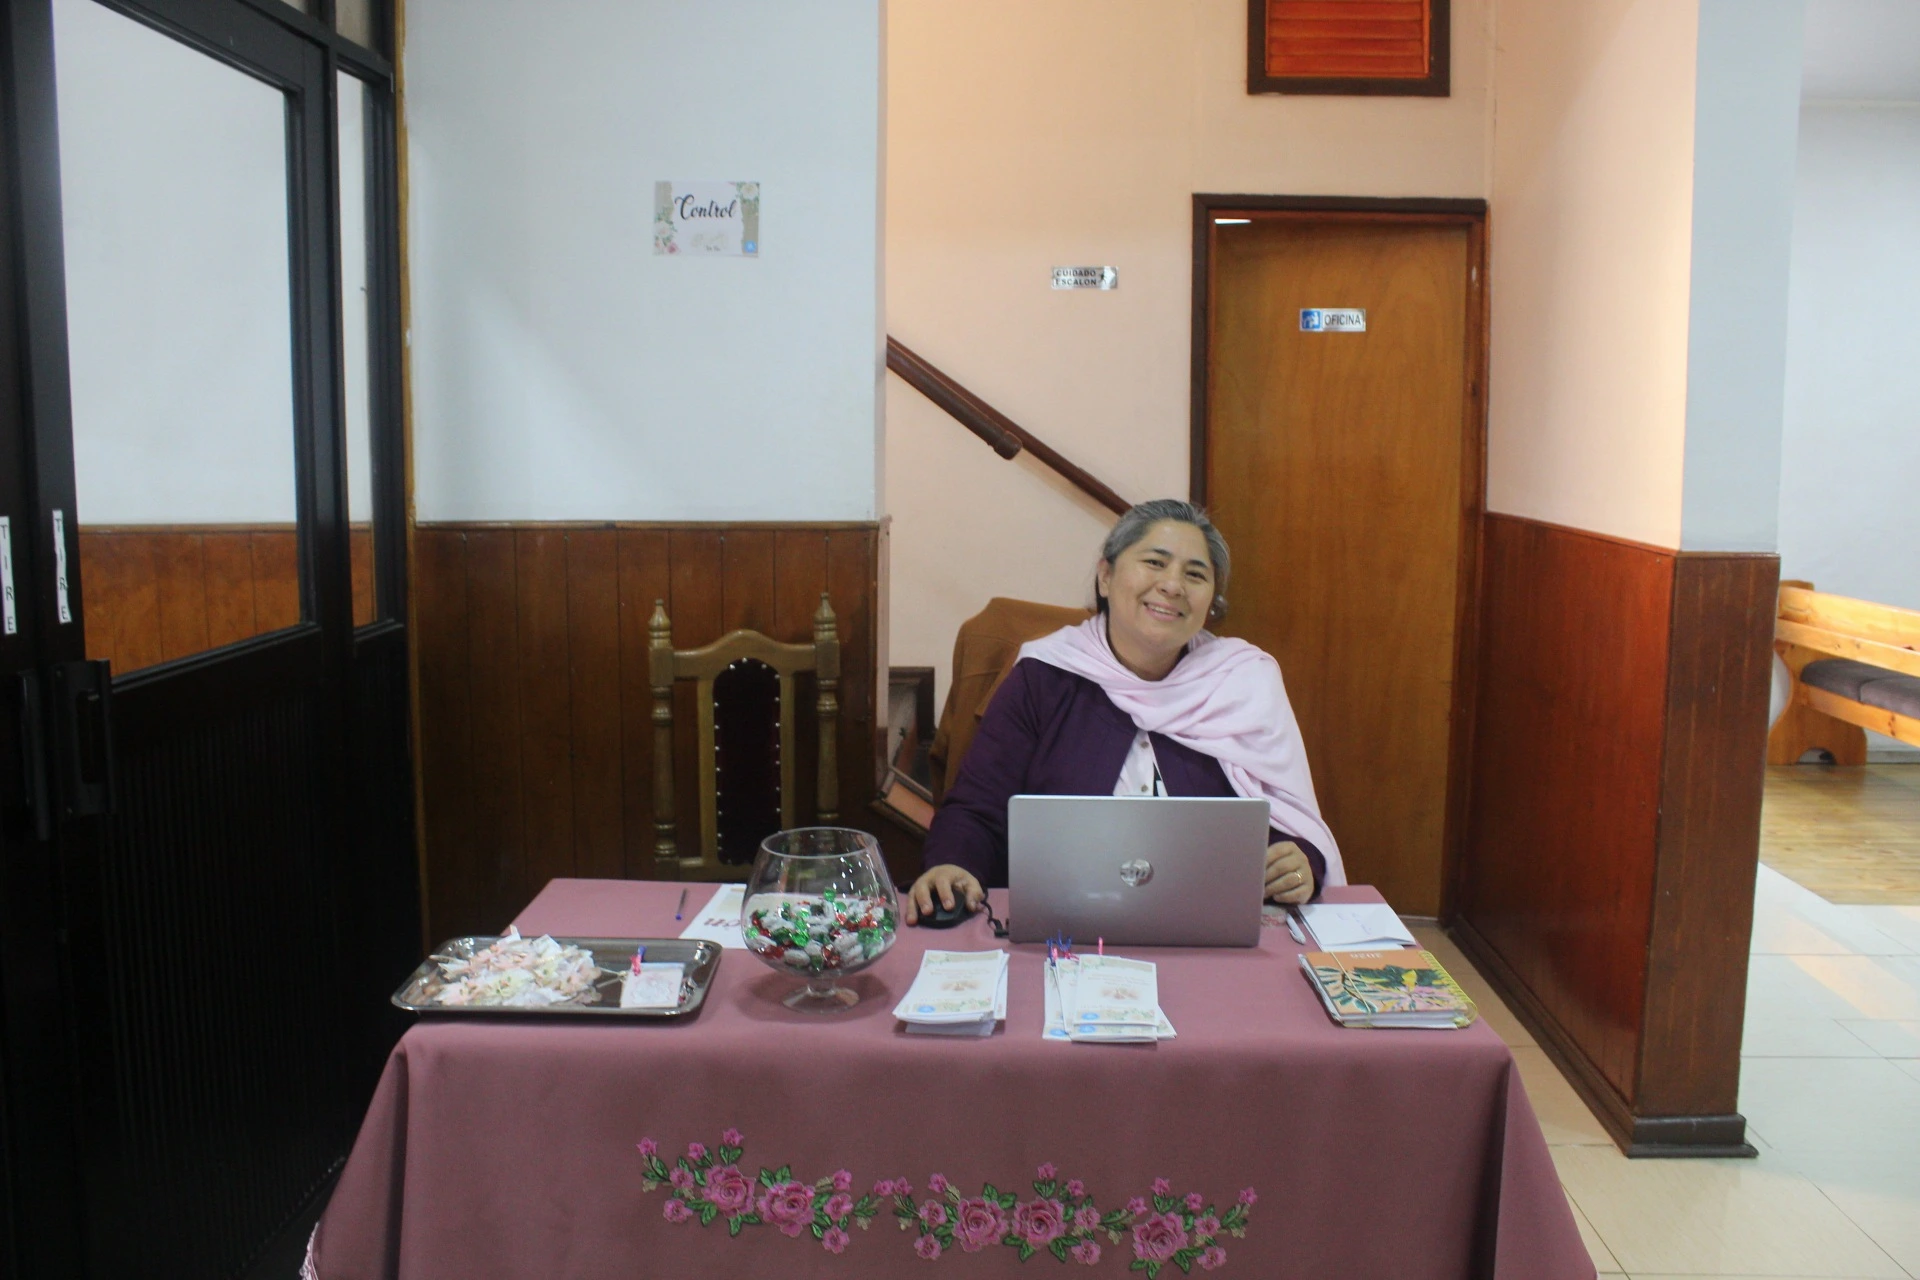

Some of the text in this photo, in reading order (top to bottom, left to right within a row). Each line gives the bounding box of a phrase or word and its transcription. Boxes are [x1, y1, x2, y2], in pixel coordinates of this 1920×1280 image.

[674, 194, 737, 220] Control
[1056, 269, 1096, 277] CUIDADO
[1324, 314, 1361, 326] OFICINA
[0, 524, 14, 632] TIRE
[55, 518, 69, 620] TIRE
